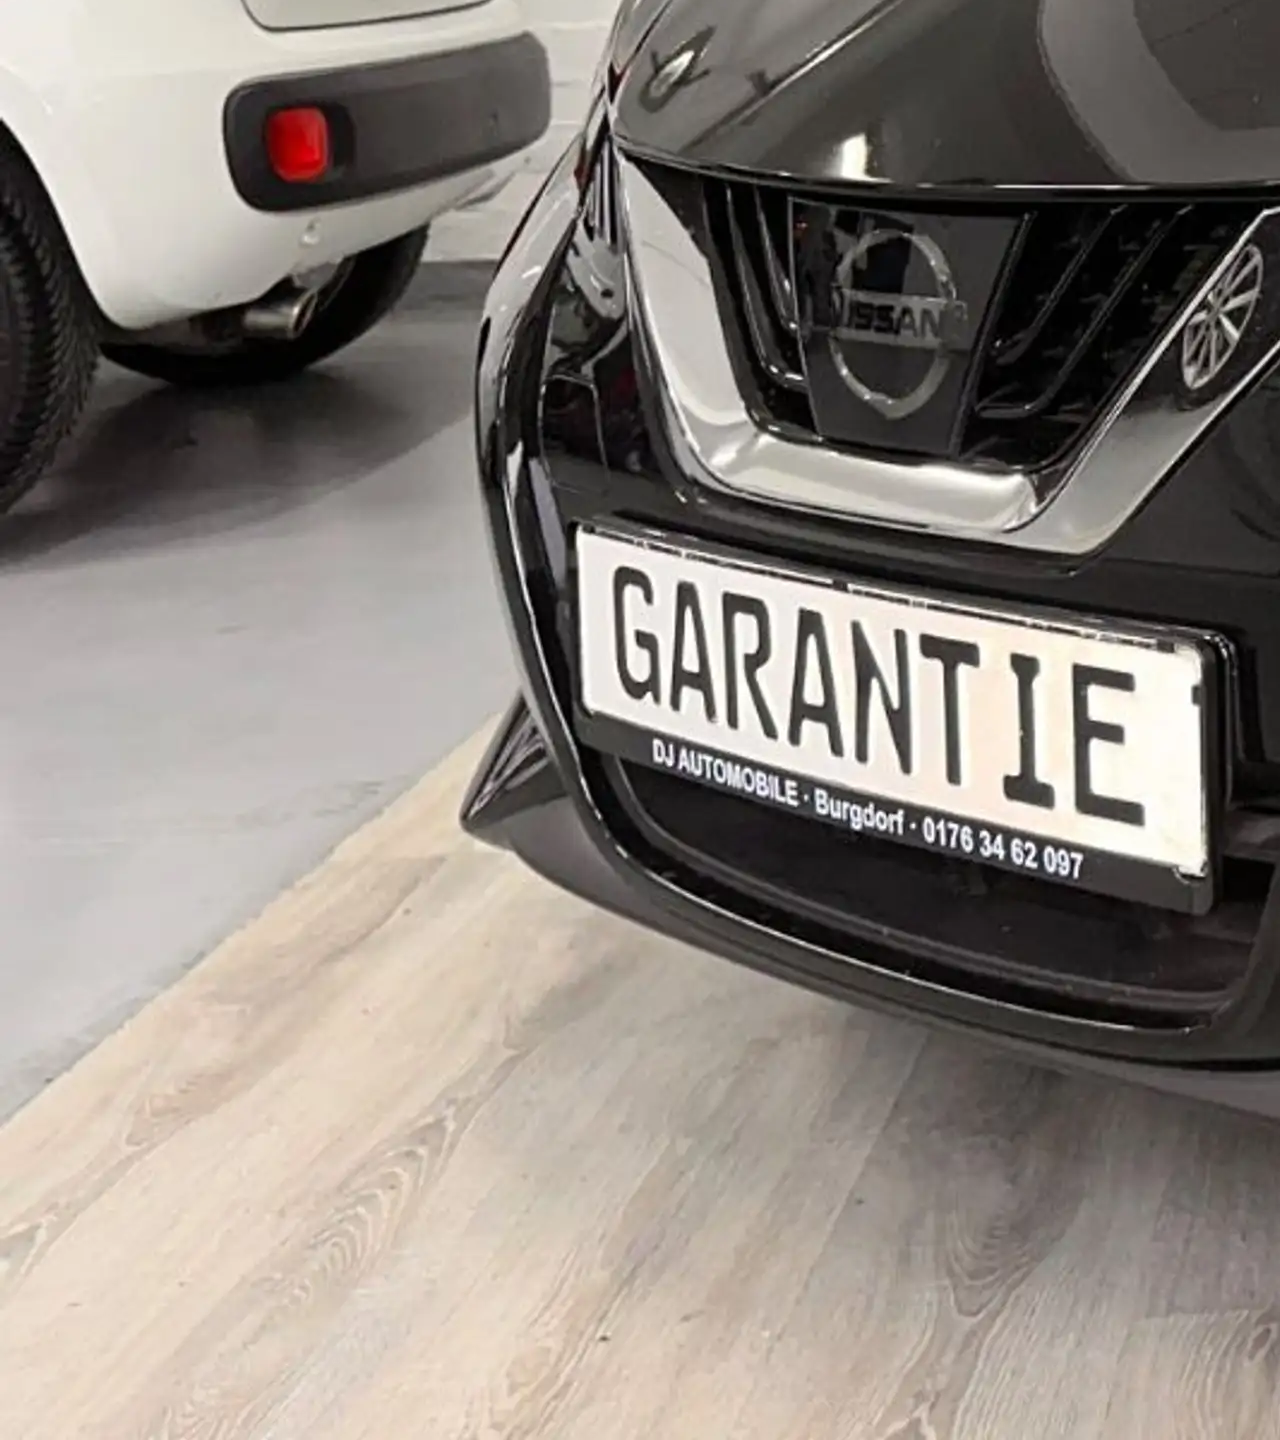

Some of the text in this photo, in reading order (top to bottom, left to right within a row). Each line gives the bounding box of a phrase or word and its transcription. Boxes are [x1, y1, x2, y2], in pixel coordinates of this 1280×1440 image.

[611, 565, 1146, 827] GARANTIE
[652, 739, 1084, 879] DJ AUTOMOBILE Burgdorf 0176 34 62 097
